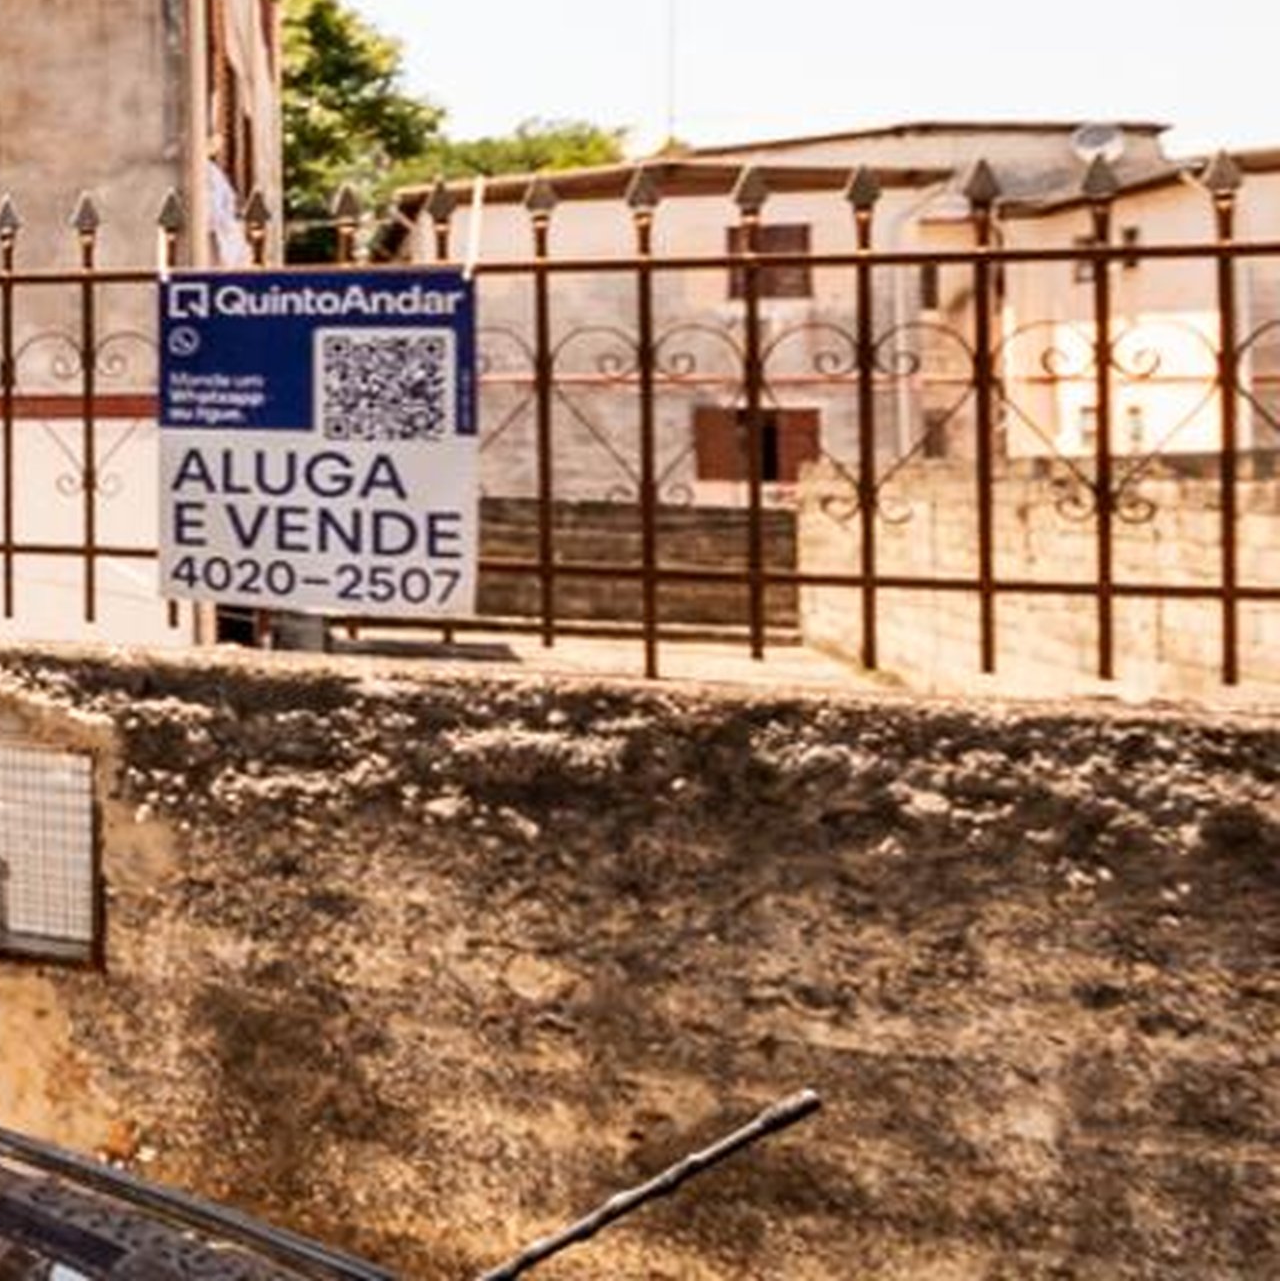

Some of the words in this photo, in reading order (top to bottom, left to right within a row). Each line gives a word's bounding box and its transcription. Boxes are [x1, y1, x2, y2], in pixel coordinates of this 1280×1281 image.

[214, 285, 463, 316] QuintoAndar
[171, 448, 407, 500] ALUGA
[174, 502, 206, 547] E
[224, 503, 462, 558] VENDE
[171, 556, 461, 604] 4020-2507
